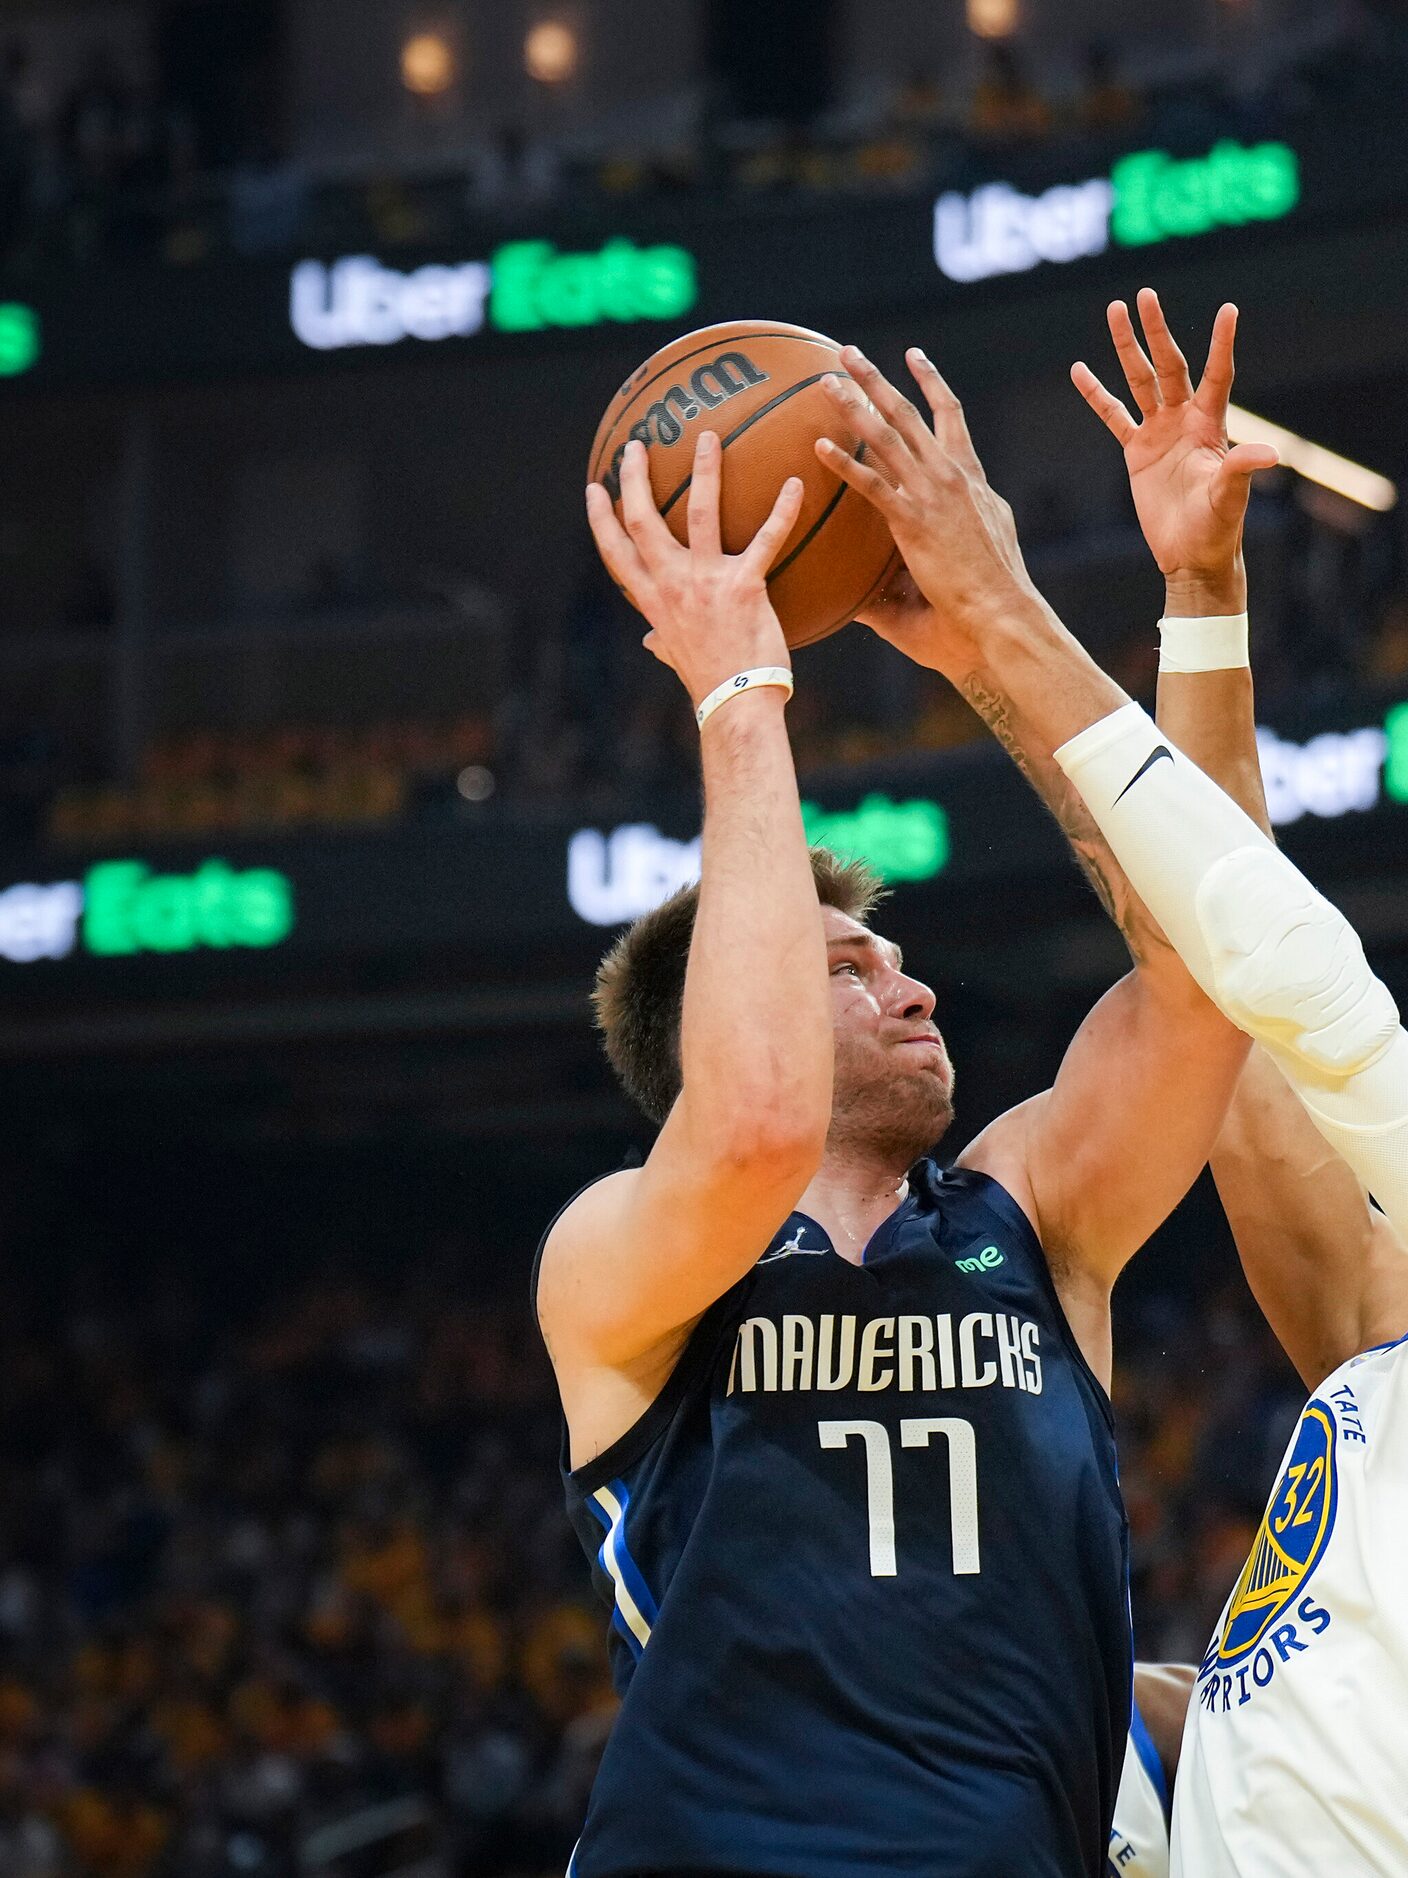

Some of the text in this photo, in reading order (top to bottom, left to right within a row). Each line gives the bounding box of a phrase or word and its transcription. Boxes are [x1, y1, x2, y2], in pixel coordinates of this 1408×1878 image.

[933, 141, 1300, 283] Uber Eats
[290, 238, 696, 349] Uber Eats
[82, 858, 293, 957] Eats
[726, 1312, 1043, 1398] MAVERICKS
[817, 1416, 981, 1577] 77
[1274, 1455, 1326, 1534] 32
